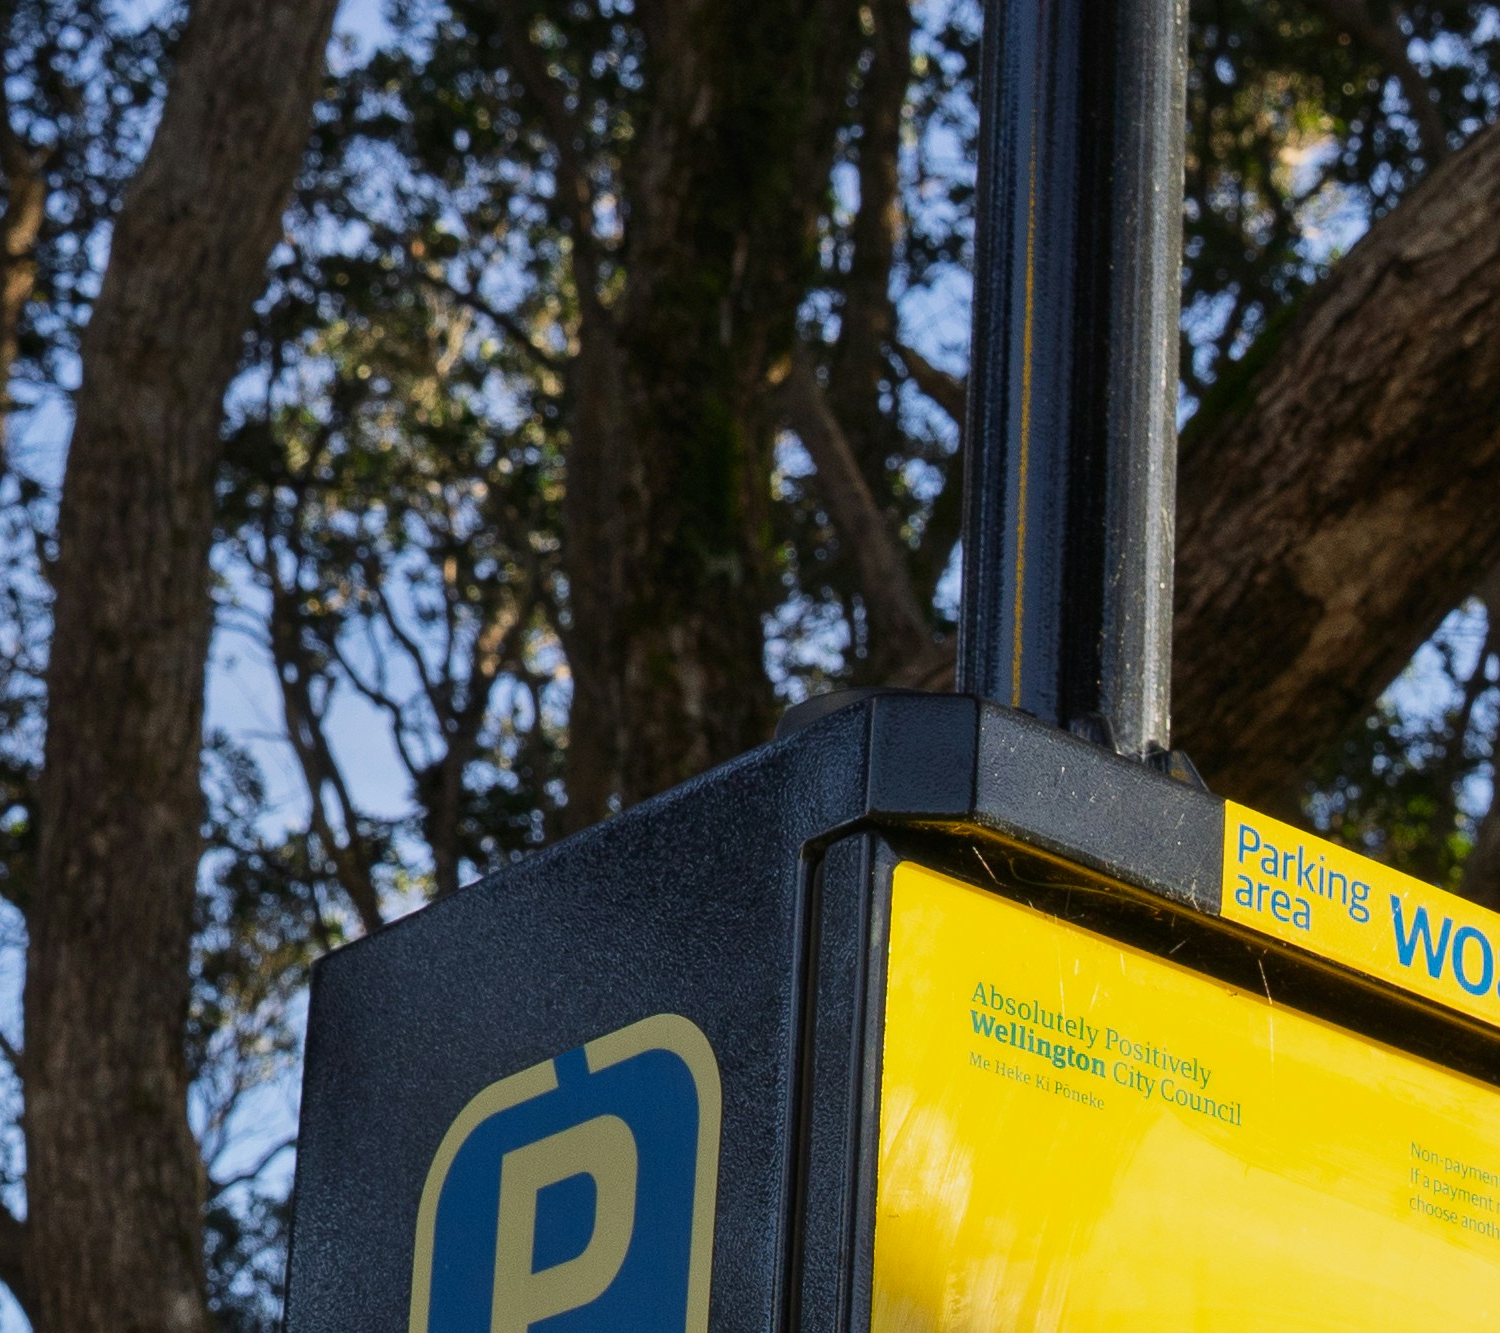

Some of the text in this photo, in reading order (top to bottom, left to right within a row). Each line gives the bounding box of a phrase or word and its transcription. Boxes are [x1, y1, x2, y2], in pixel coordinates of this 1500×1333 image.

[1235, 874, 1311, 932] area
[1237, 823, 1371, 924] Parking
[971, 981, 1212, 1090] Absolutely Positively
[969, 1051, 1105, 1110] Me Heke Ki Pōneke
[970, 1008, 1242, 1126] Wellington City Council
[1409, 1195, 1457, 1224] choose
[1410, 1168, 1420, 1184] If
[1423, 1175, 1430, 1188] a
[1433, 1178, 1494, 1212] payment
